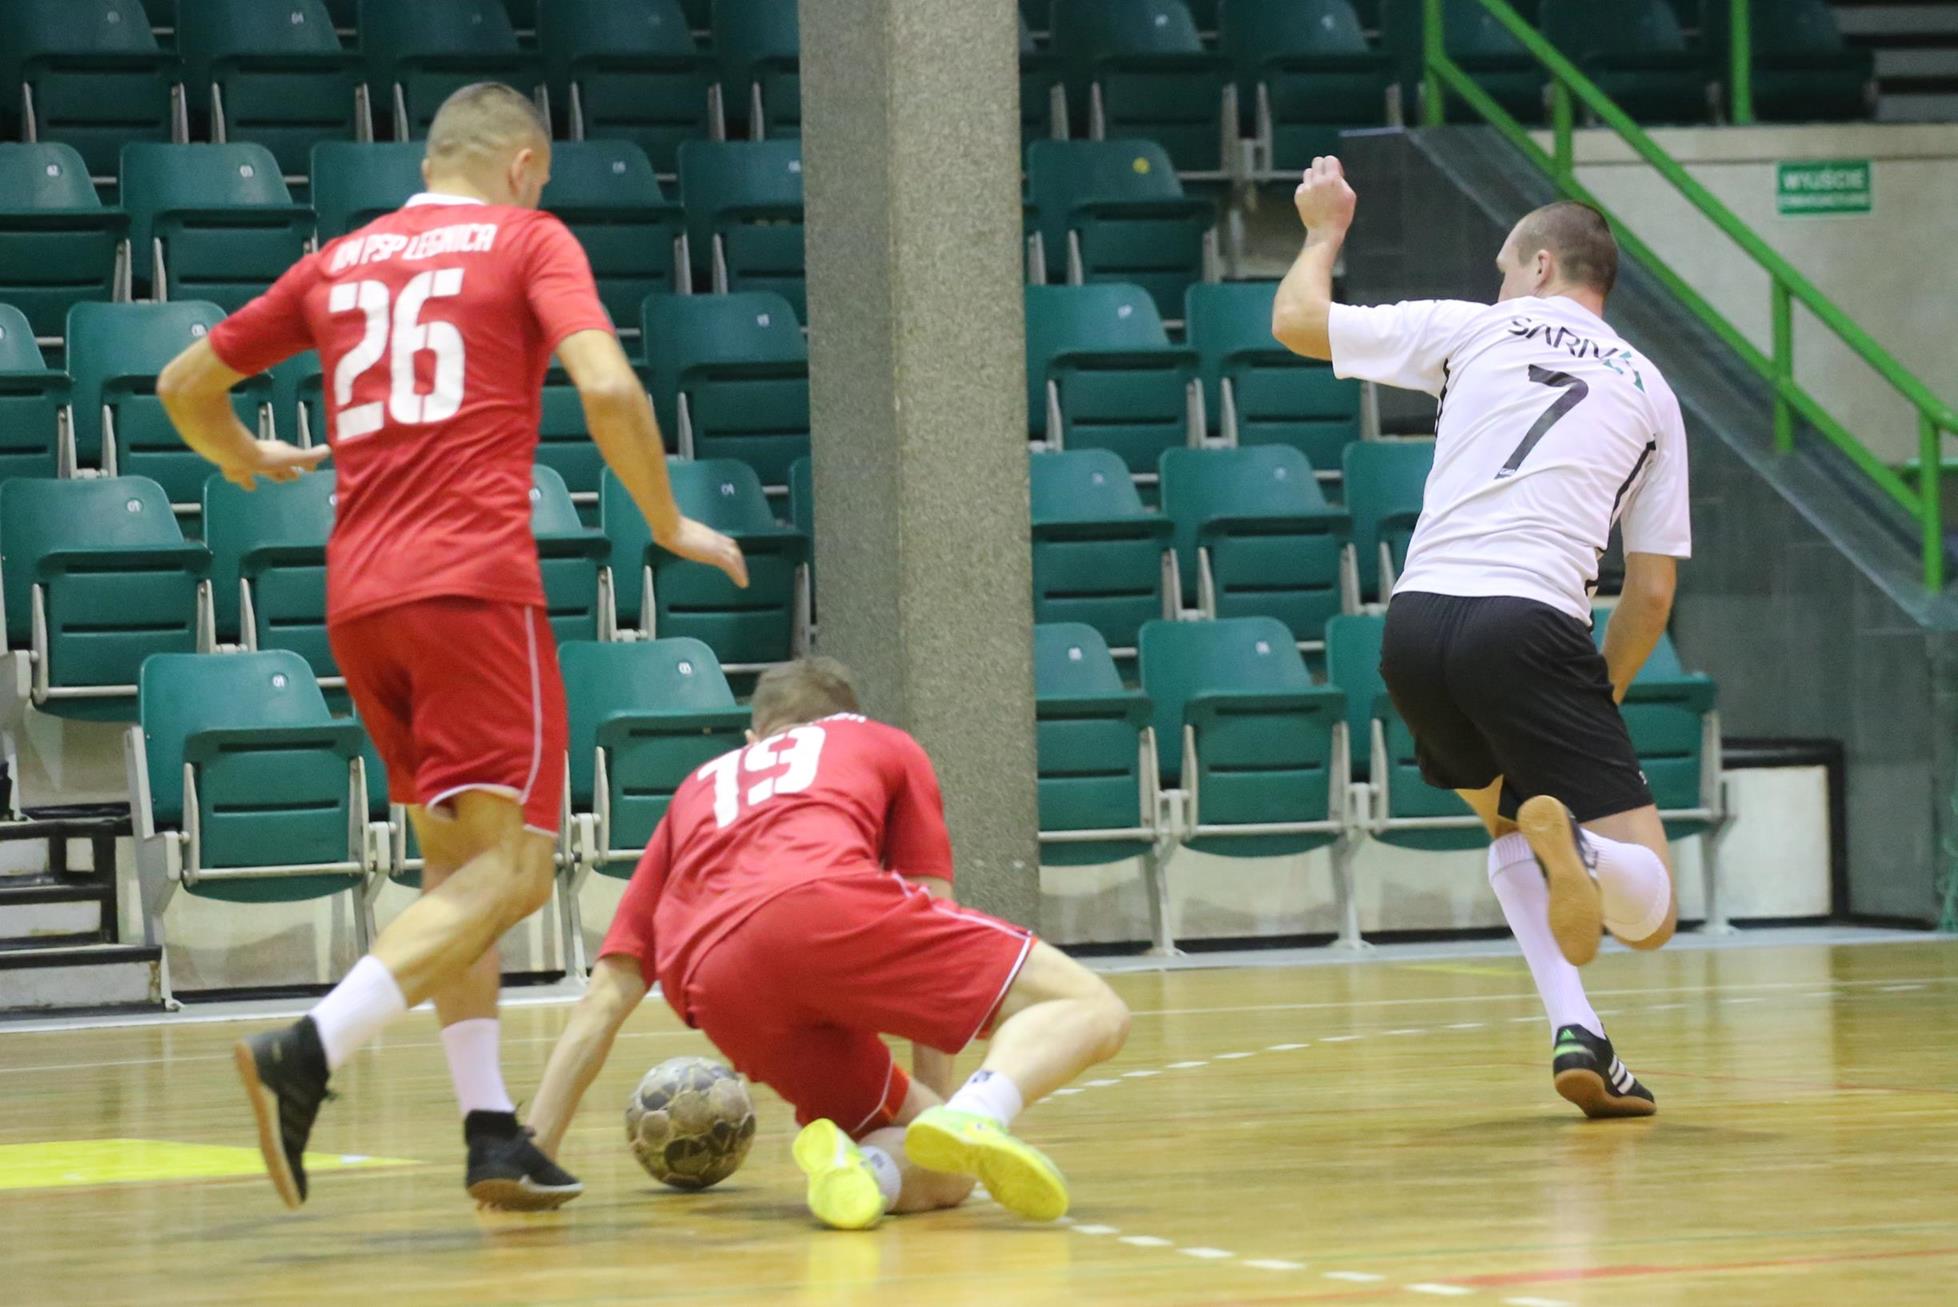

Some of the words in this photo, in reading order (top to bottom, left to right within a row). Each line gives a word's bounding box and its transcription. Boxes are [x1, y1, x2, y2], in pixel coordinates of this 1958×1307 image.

[329, 268, 465, 441] 26
[1494, 364, 1589, 479] 7
[697, 727, 826, 828] 19
